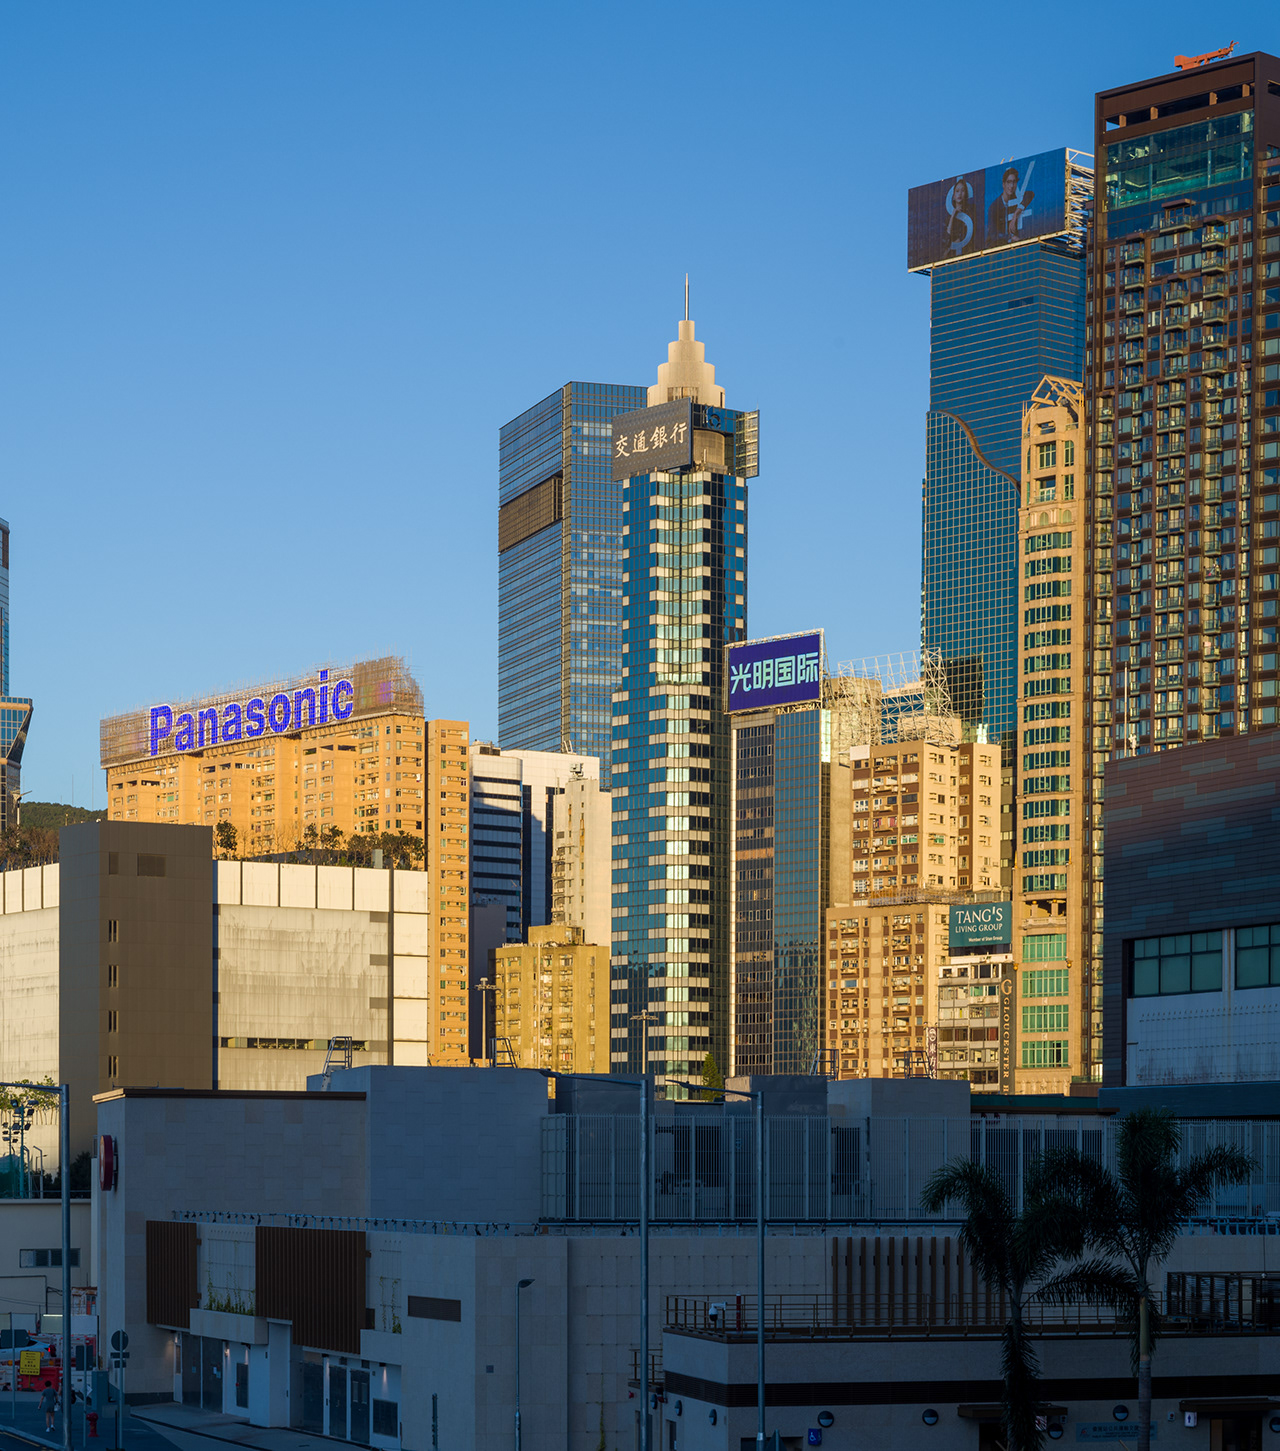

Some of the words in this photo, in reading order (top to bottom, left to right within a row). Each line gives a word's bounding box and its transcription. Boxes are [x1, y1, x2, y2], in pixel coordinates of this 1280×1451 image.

[614, 421, 688, 459] 交通銀行
[731, 651, 819, 695] 光明国际
[150, 668, 355, 757] Panasonic
[955, 906, 1004, 924] TANG'S
[955, 924, 977, 934] LIVING
[978, 923, 1004, 932] GROUP
[1000, 979, 1013, 995] G
[1002, 997, 1011, 1079] GLOUCESTER
